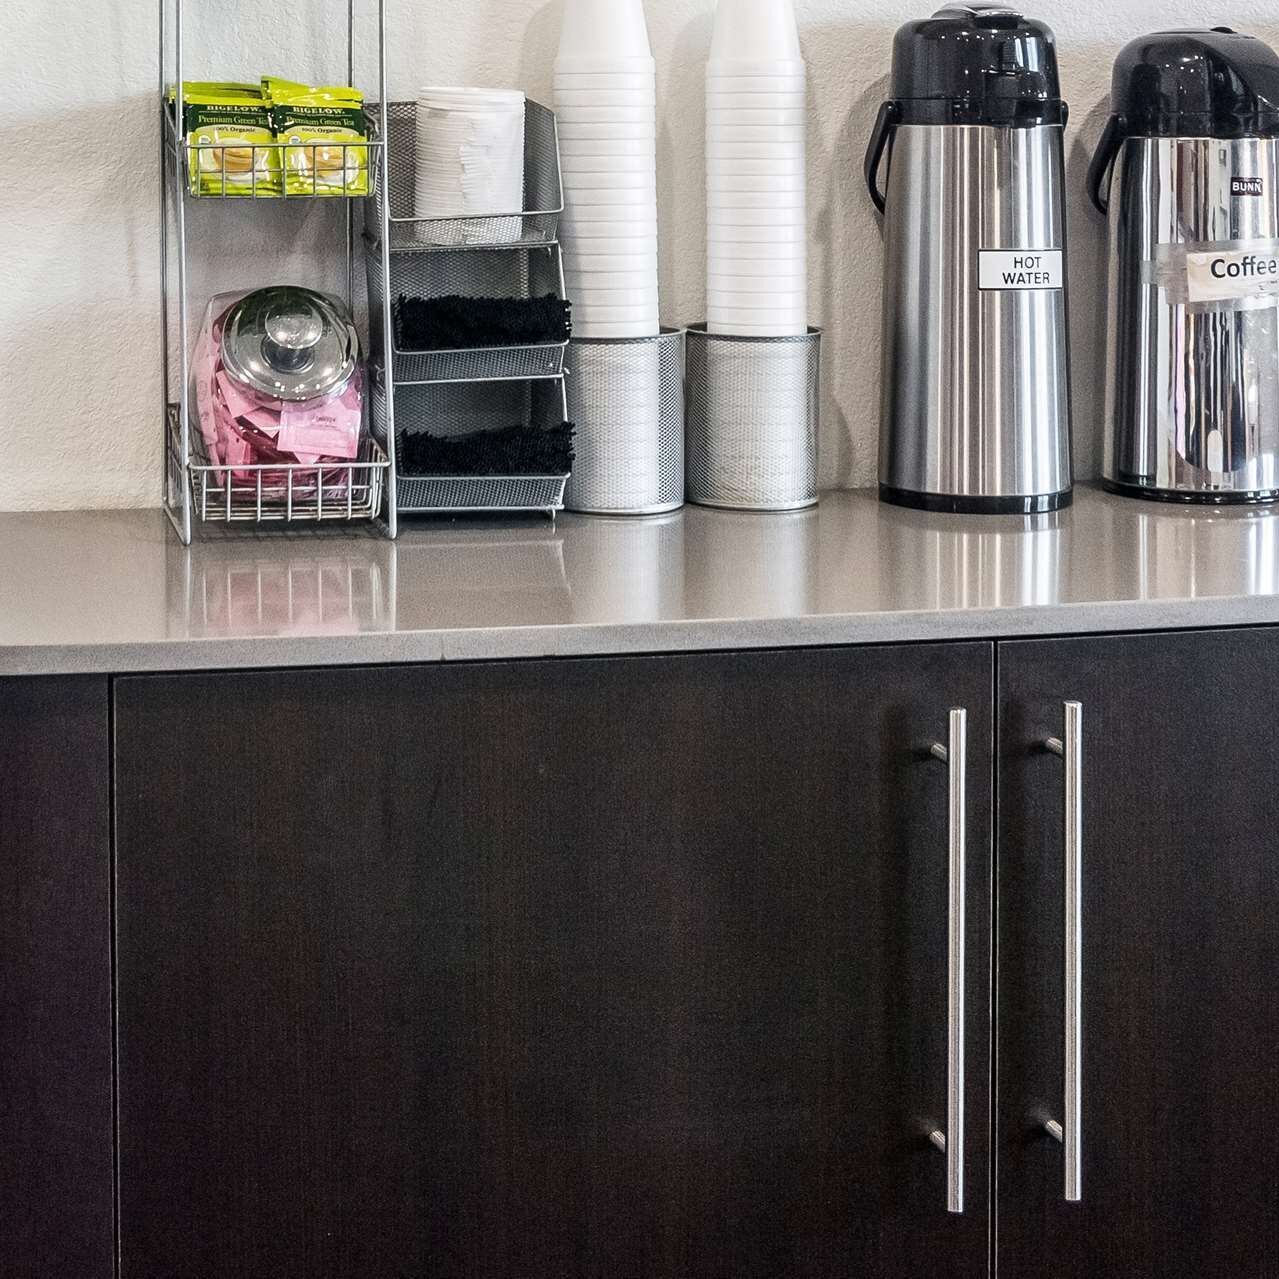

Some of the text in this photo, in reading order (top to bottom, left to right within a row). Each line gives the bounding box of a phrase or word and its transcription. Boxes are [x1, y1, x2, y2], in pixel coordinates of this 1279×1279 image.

[233, 116, 257, 125] Green
[1232, 181, 1262, 193] BUNN
[1013, 256, 1042, 269] HOT
[1210, 255, 1277, 279] Coffee
[1001, 272, 1050, 285] WATER
